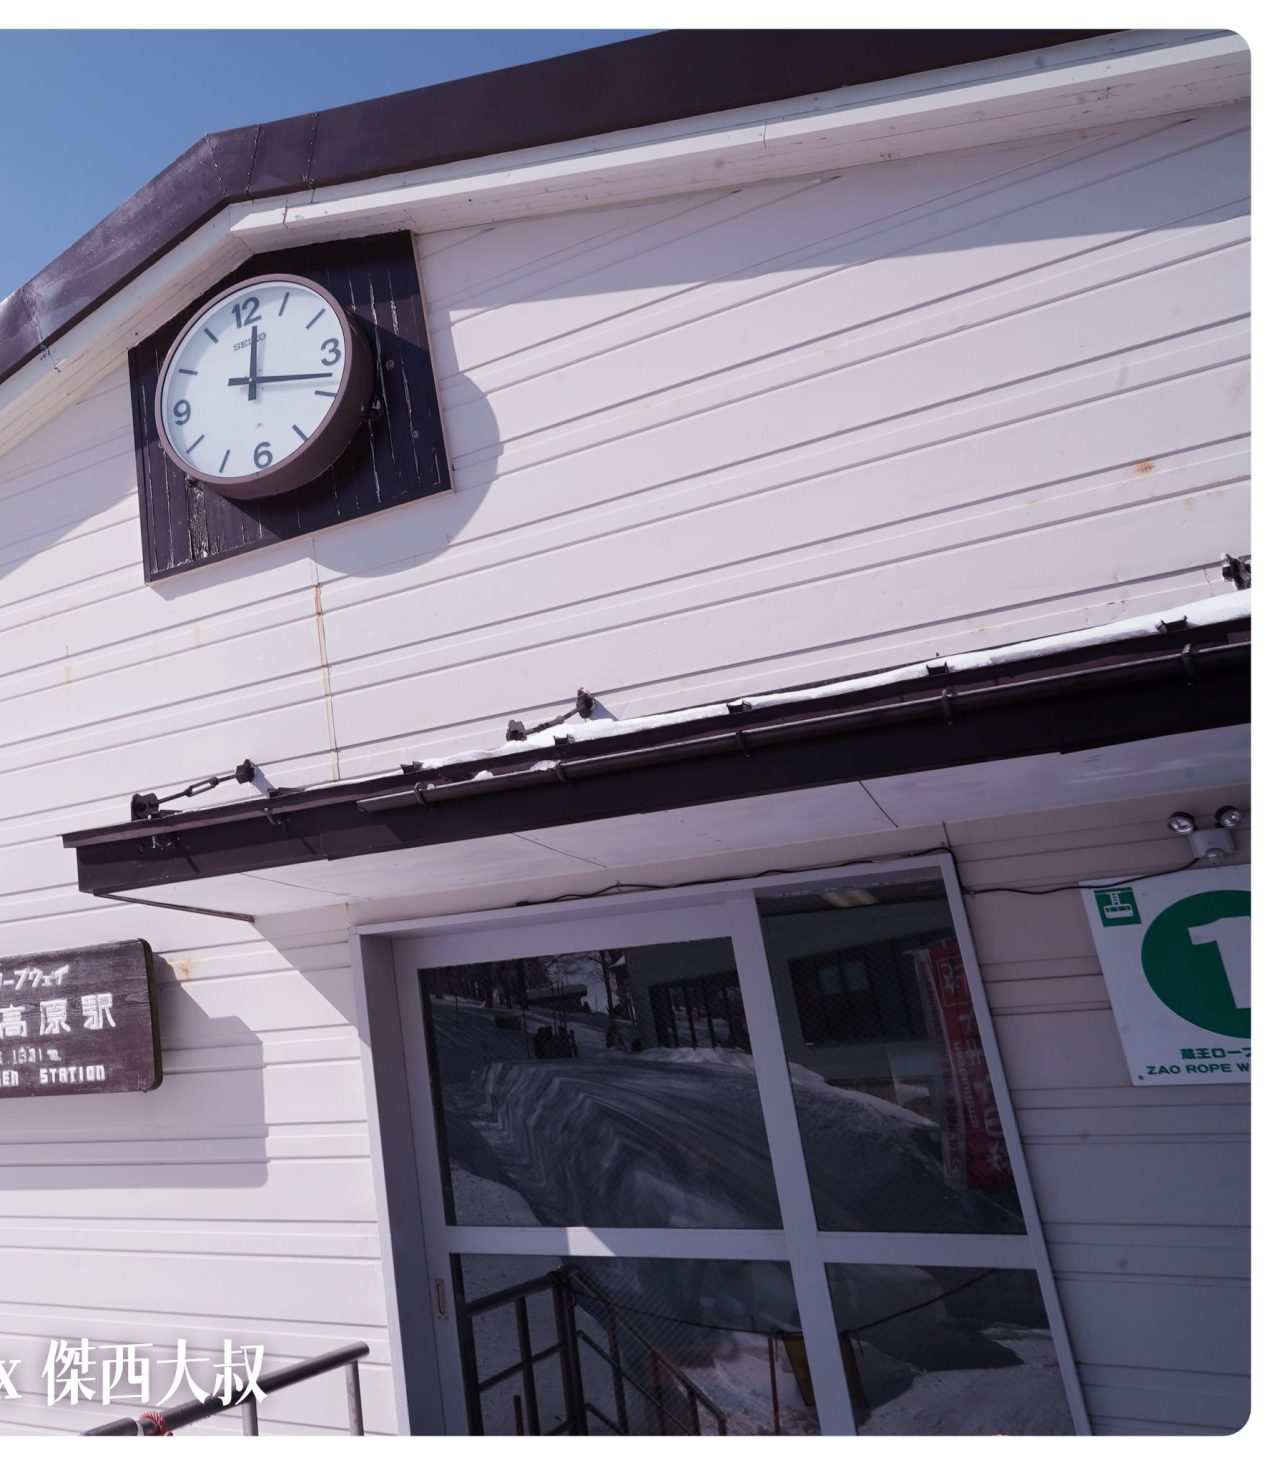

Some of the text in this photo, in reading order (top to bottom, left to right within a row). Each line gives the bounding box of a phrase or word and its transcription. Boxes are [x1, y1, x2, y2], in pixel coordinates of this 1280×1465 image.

[231, 296, 262, 329] 12
[320, 338, 342, 366] 3
[173, 399, 191, 426] 9
[253, 441, 273, 469] 6
[39, 1064, 106, 1085] STATION
[1147, 1064, 1181, 1075] ZAO
[1186, 1062, 1232, 1074] ROPE
